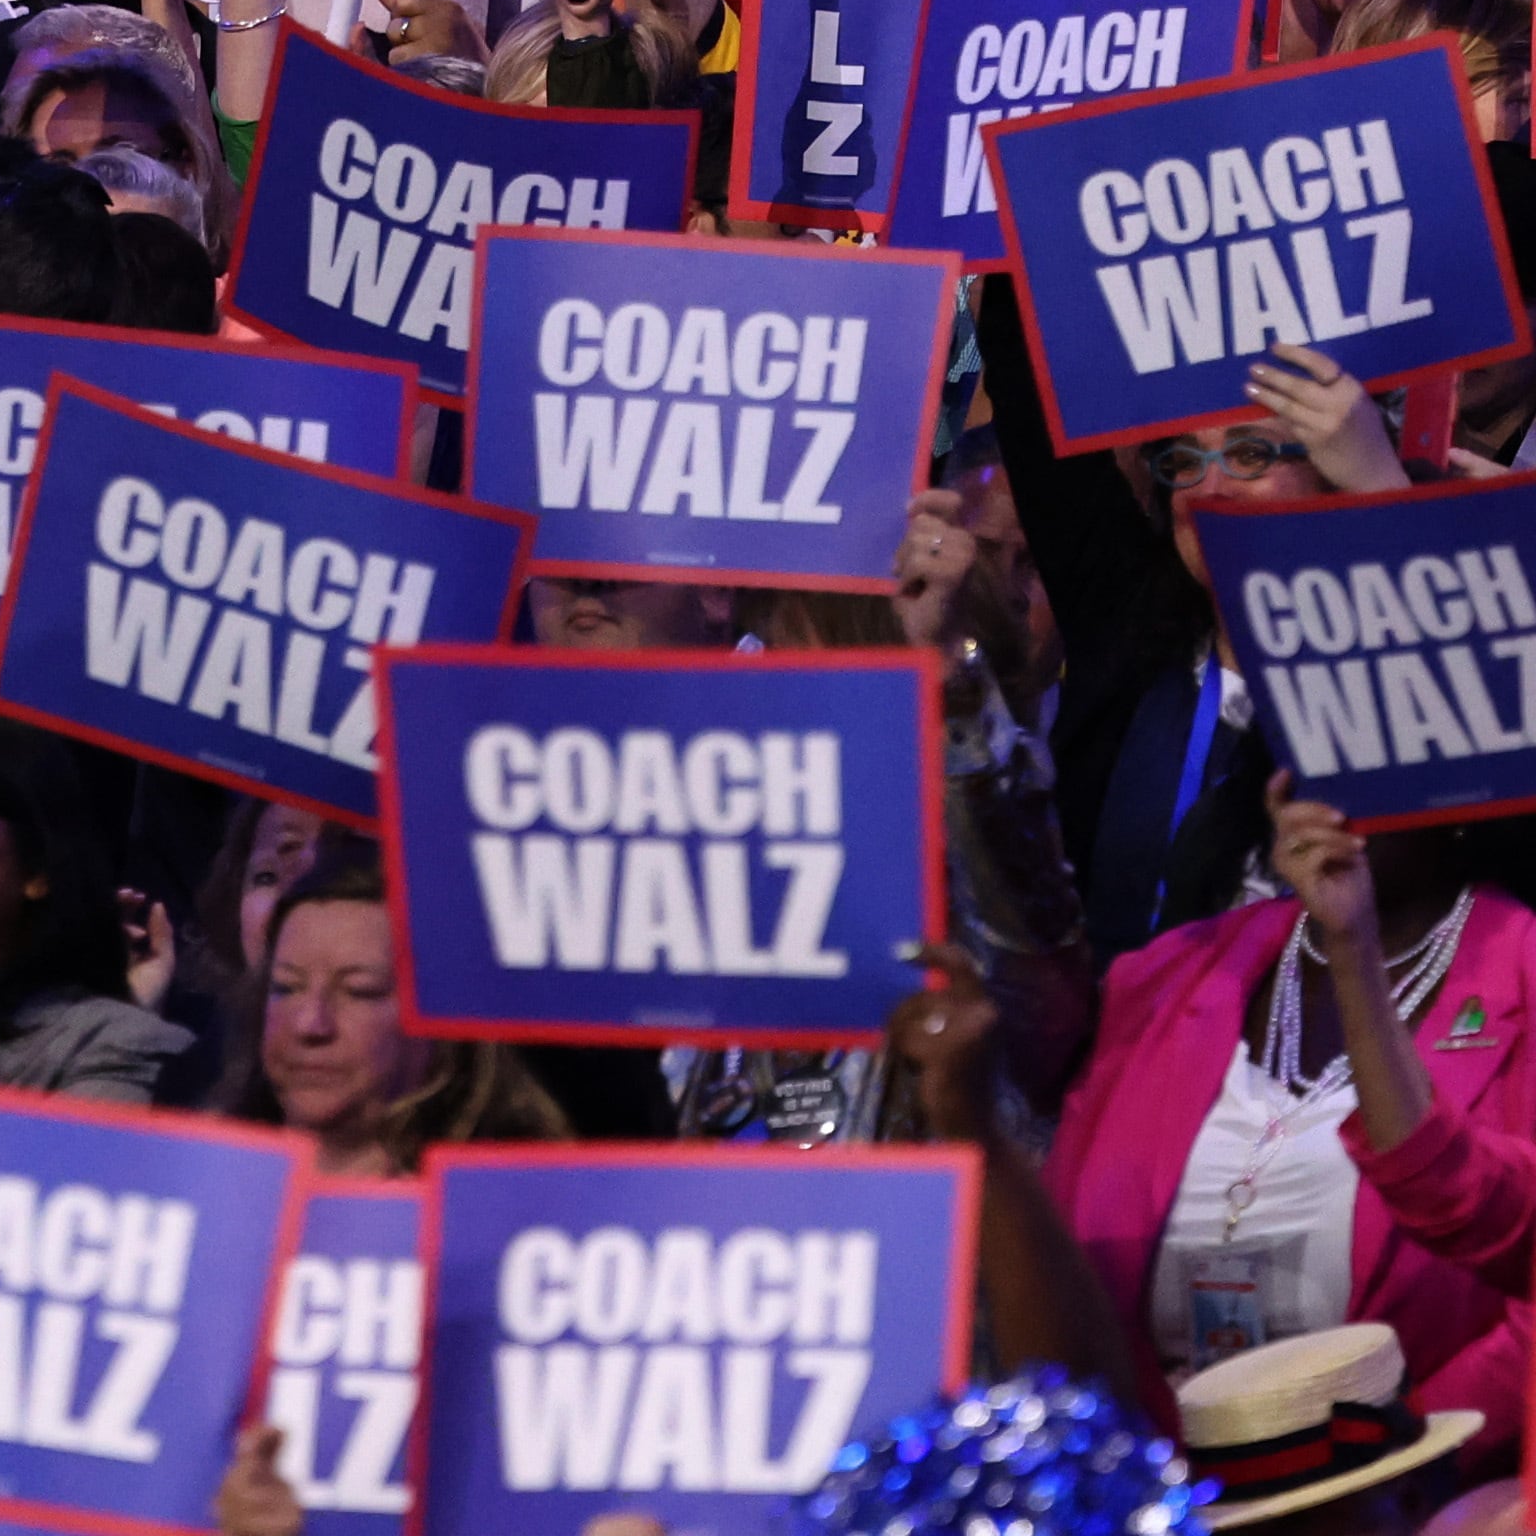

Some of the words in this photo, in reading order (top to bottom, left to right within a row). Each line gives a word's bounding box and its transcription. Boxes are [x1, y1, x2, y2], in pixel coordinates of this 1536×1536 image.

[955, 7, 1187, 106] COACH
[319, 117, 629, 241] COACH
[1078, 119, 1405, 258] COACH
[537, 297, 867, 404] COACH
[1096, 207, 1433, 375] WALZ
[532, 392, 856, 525] WALZ
[95, 475, 436, 646] COACH
[1242, 544, 1536, 659] COACH
[462, 723, 842, 836] COACH
[471, 834, 850, 978] WALZ
[495, 1226, 877, 1346] COACH
[494, 1345, 873, 1496] WALZ
